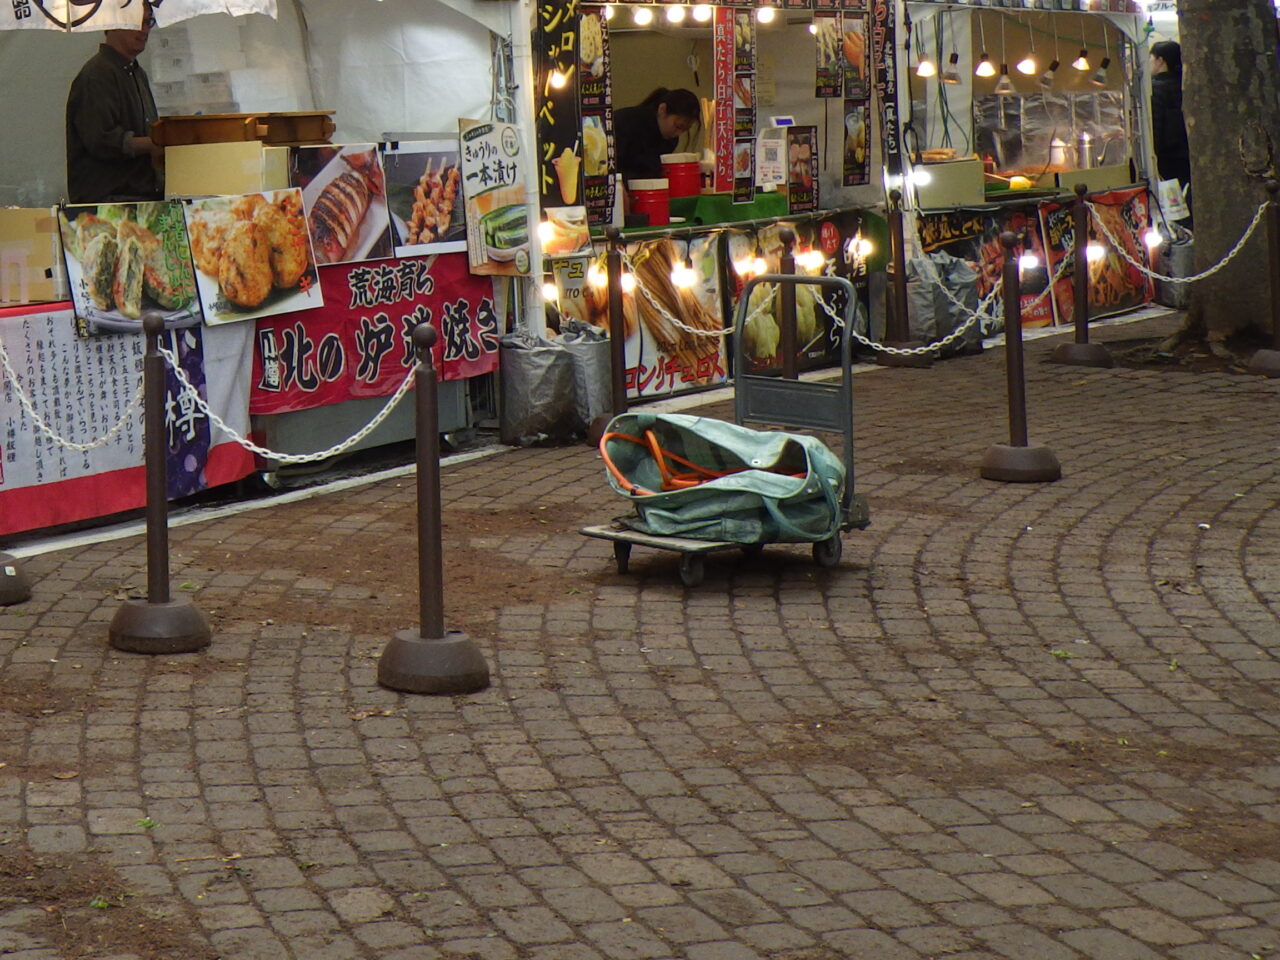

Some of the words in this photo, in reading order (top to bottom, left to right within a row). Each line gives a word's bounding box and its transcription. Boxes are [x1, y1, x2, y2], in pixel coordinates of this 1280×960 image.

[716, 23, 728, 176] 真たら白子天ぷら
[464, 140, 498, 162] きゅうりの
[465, 159, 518, 187] 一本漬け
